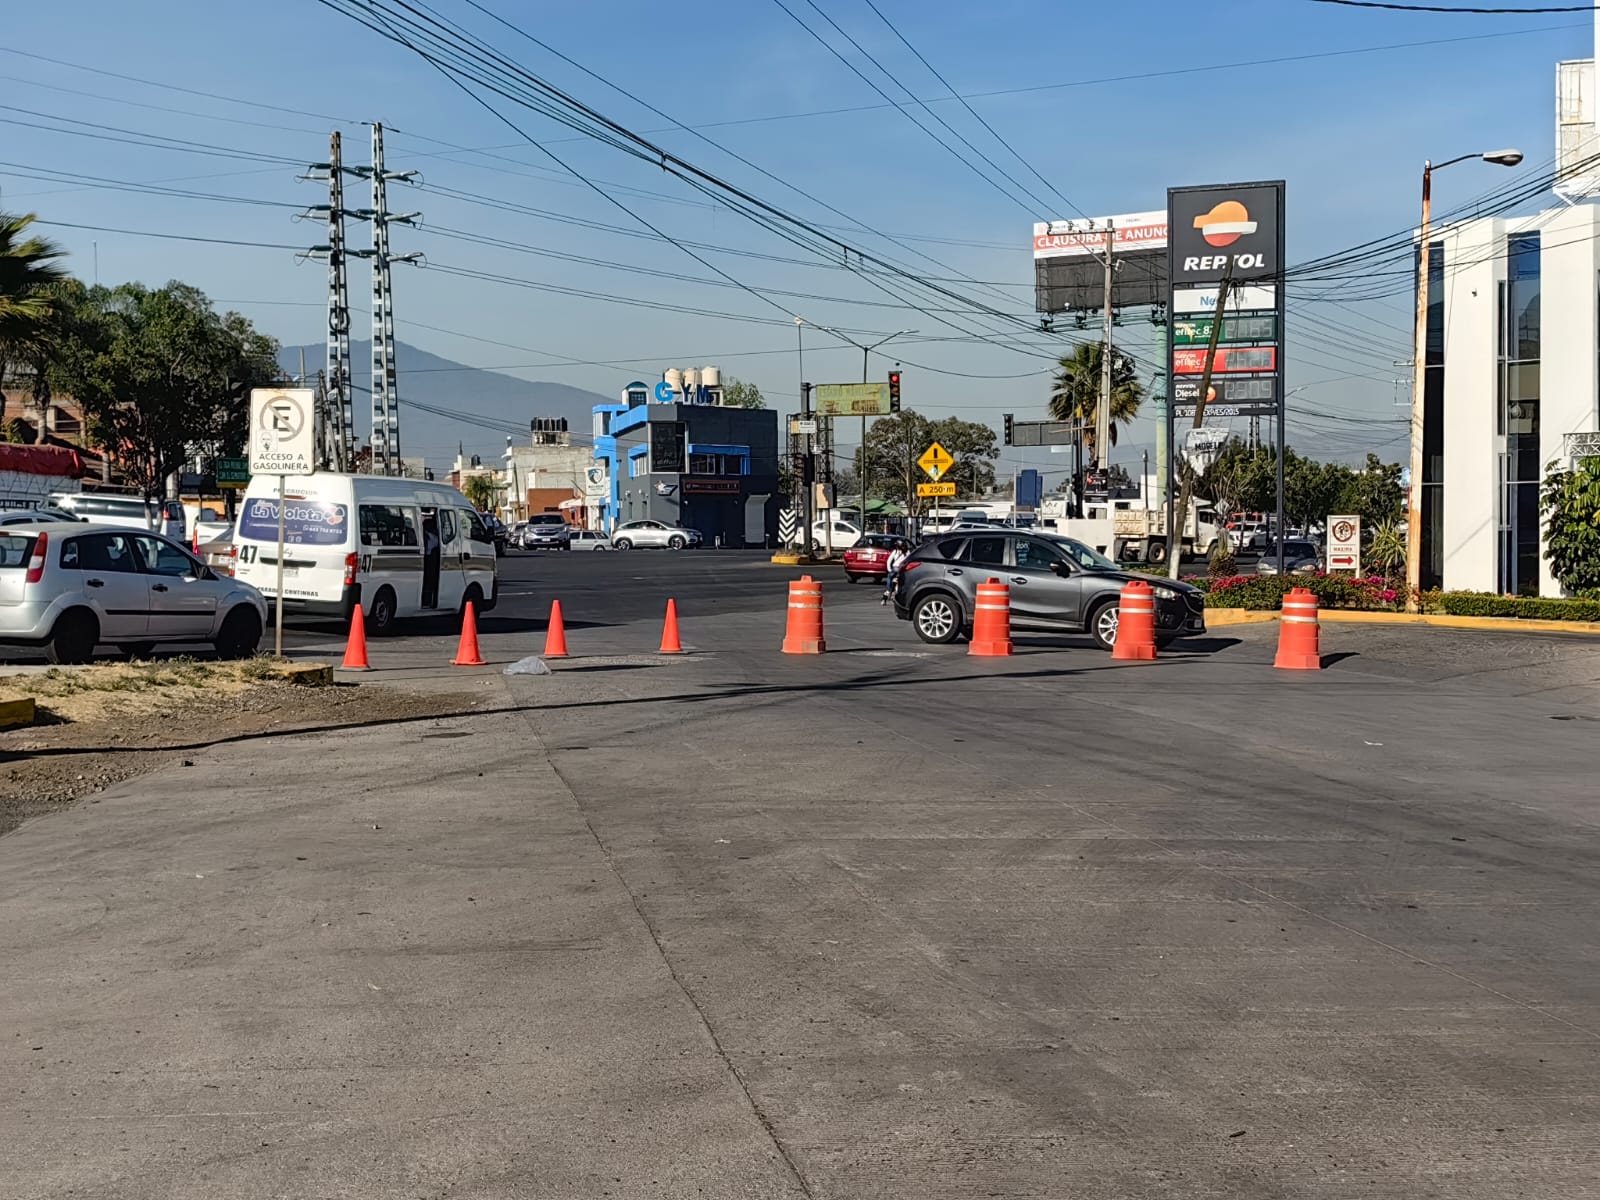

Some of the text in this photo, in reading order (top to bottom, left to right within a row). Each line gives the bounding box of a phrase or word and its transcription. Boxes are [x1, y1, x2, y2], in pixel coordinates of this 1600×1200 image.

[1037, 231, 1103, 247] CLAUSURA
[655, 381, 711, 404] GYM
[1175, 389, 1200, 398] Diesel
[259, 453, 304, 461] ACCESO A
[253, 462, 309, 470] GASOLINERA
[929, 486, 942, 494] 250
[251, 504, 269, 519] La
[271, 505, 323, 522] Voleta
[240, 545, 257, 564] 47
[361, 554, 372, 573] 47
